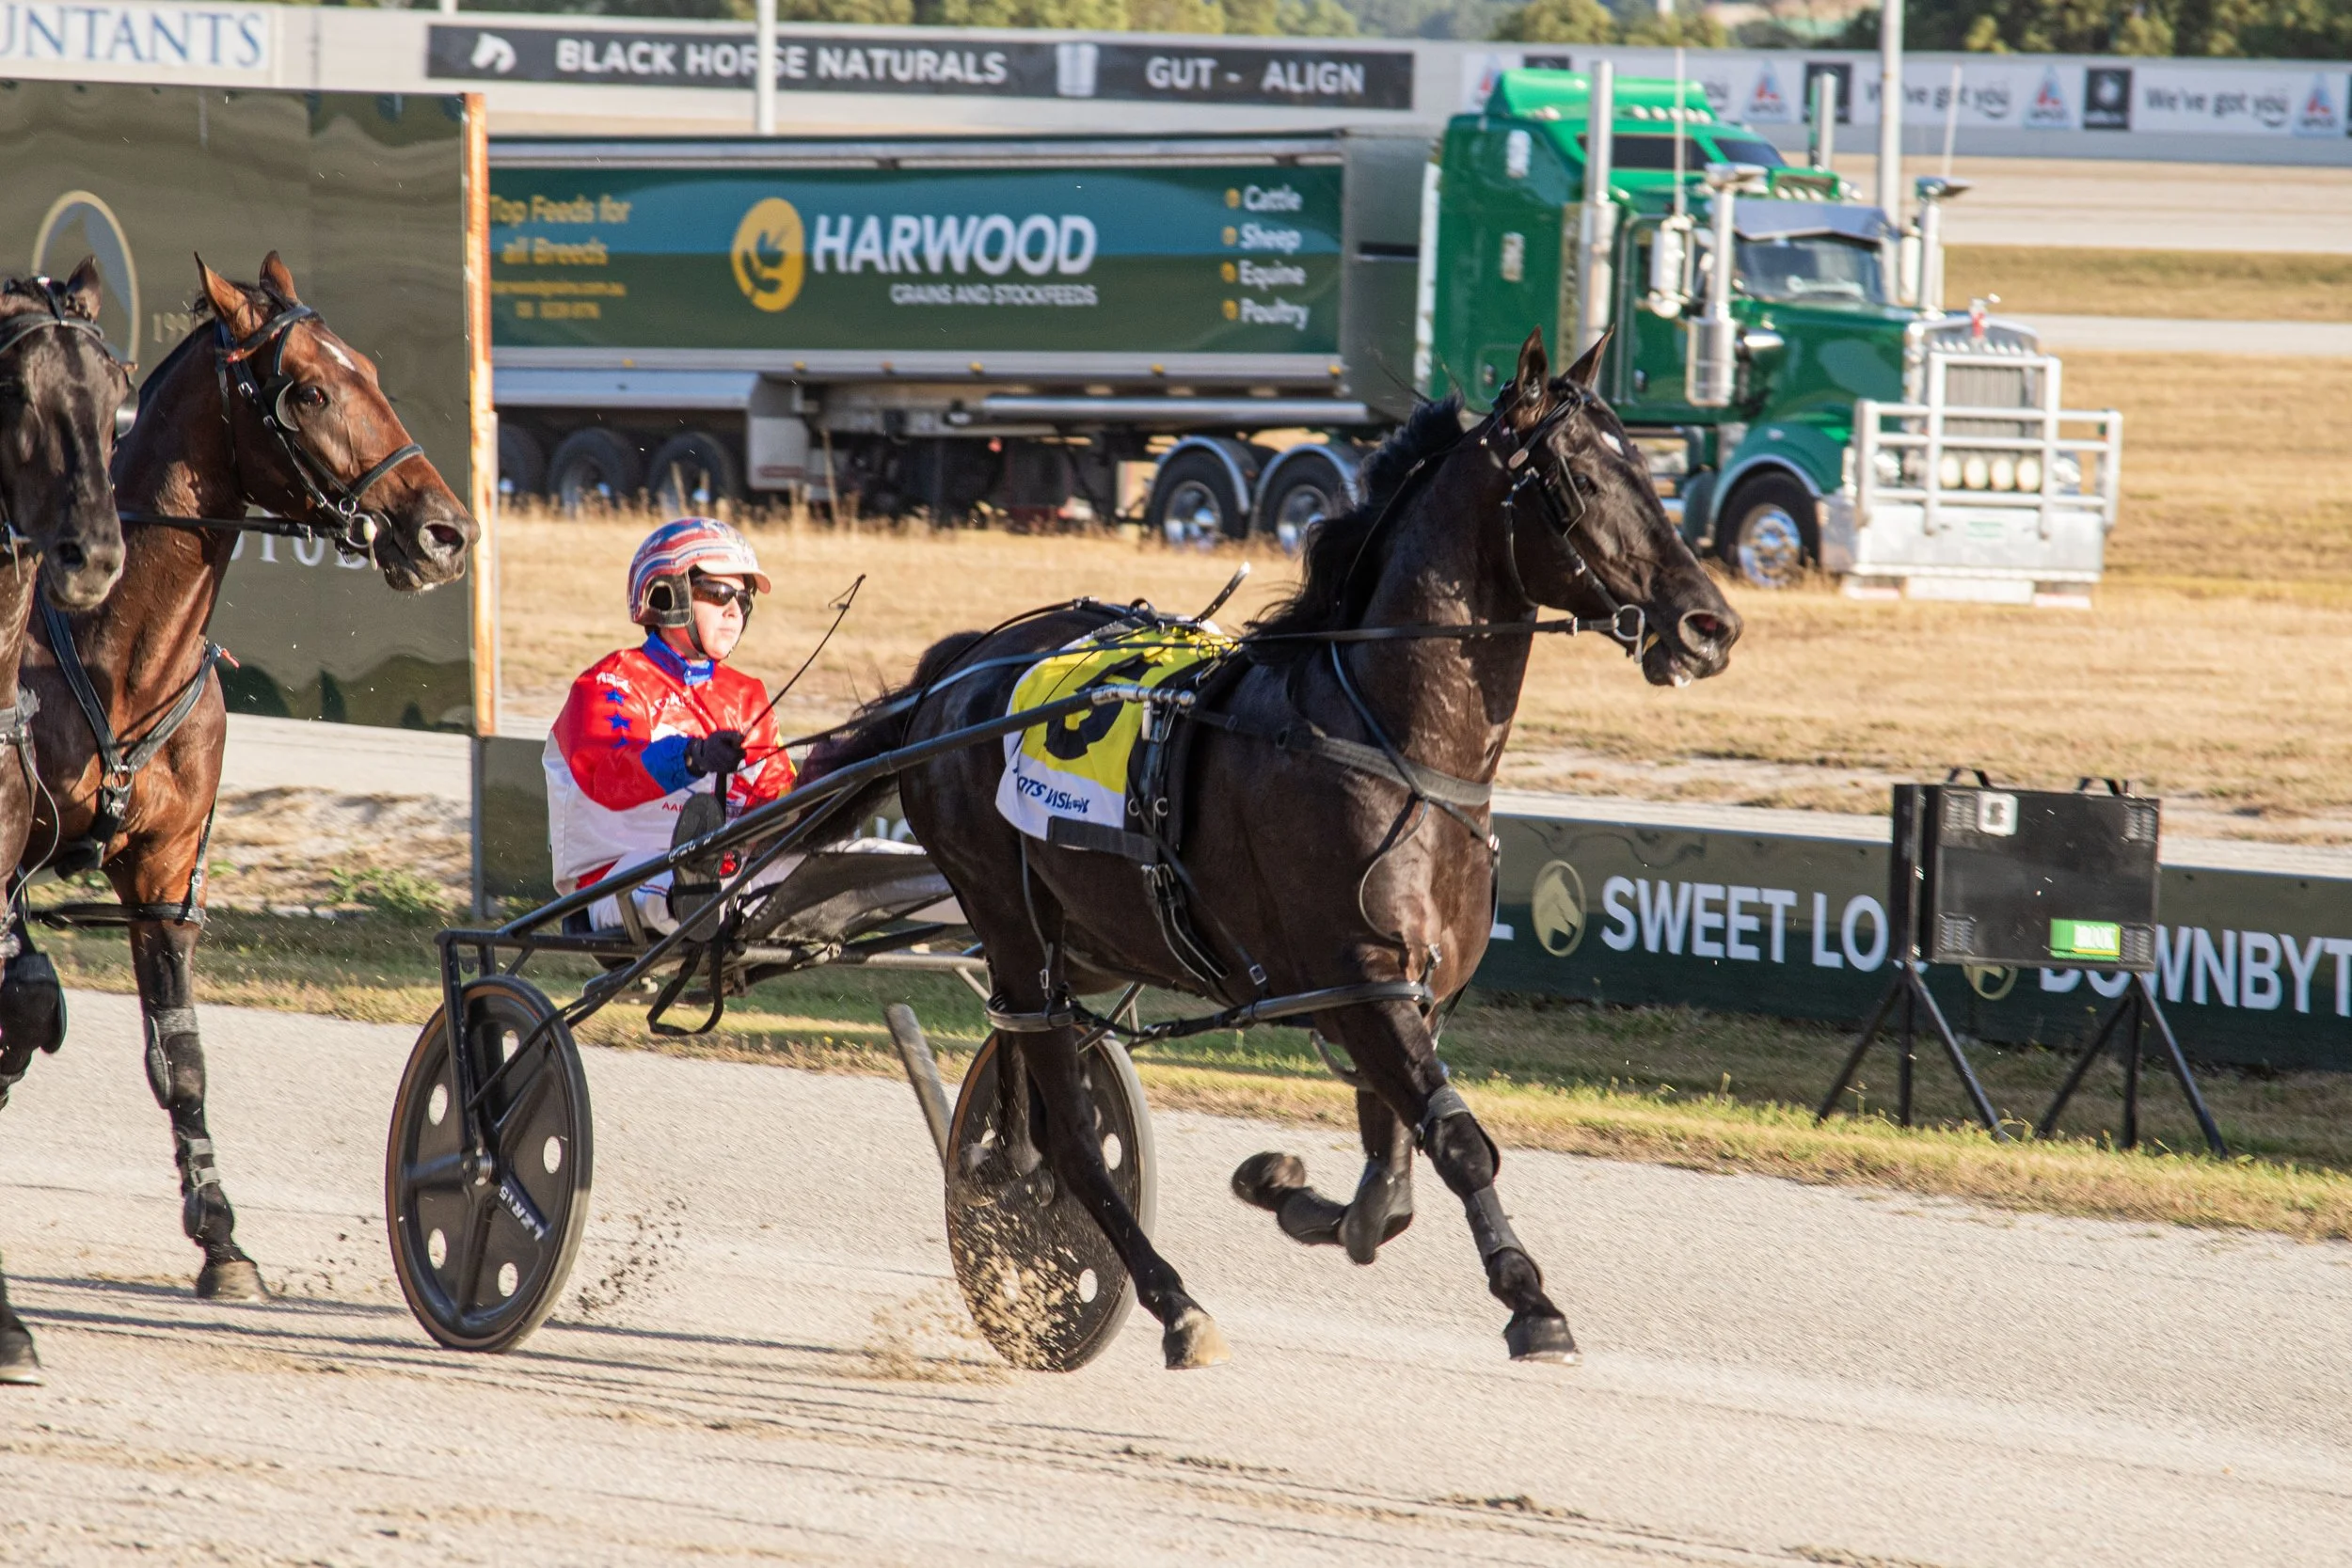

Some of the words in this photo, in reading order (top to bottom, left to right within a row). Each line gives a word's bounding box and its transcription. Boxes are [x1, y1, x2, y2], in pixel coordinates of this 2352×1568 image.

[556, 39, 676, 75] BLACK
[816, 47, 1008, 85] NATURALS
[1146, 55, 1217, 89] GUT
[1262, 60, 1364, 94] ALIGN
[532, 194, 595, 223] Feeds
[599, 194, 632, 223] for
[1244, 184, 1303, 212] Cattle
[502, 236, 528, 264] all
[533, 237, 608, 265] Breeds
[813, 214, 1097, 276] HARWOOD
[1240, 223, 1302, 255] Sheep
[1238, 260, 1306, 292] Equine
[890, 283, 952, 305] GRAINS
[955, 283, 991, 305] AND
[993, 283, 1098, 307] STOCKFEEDS
[1240, 297, 1310, 331] Poultry
[1600, 875, 1797, 963] SWEET
